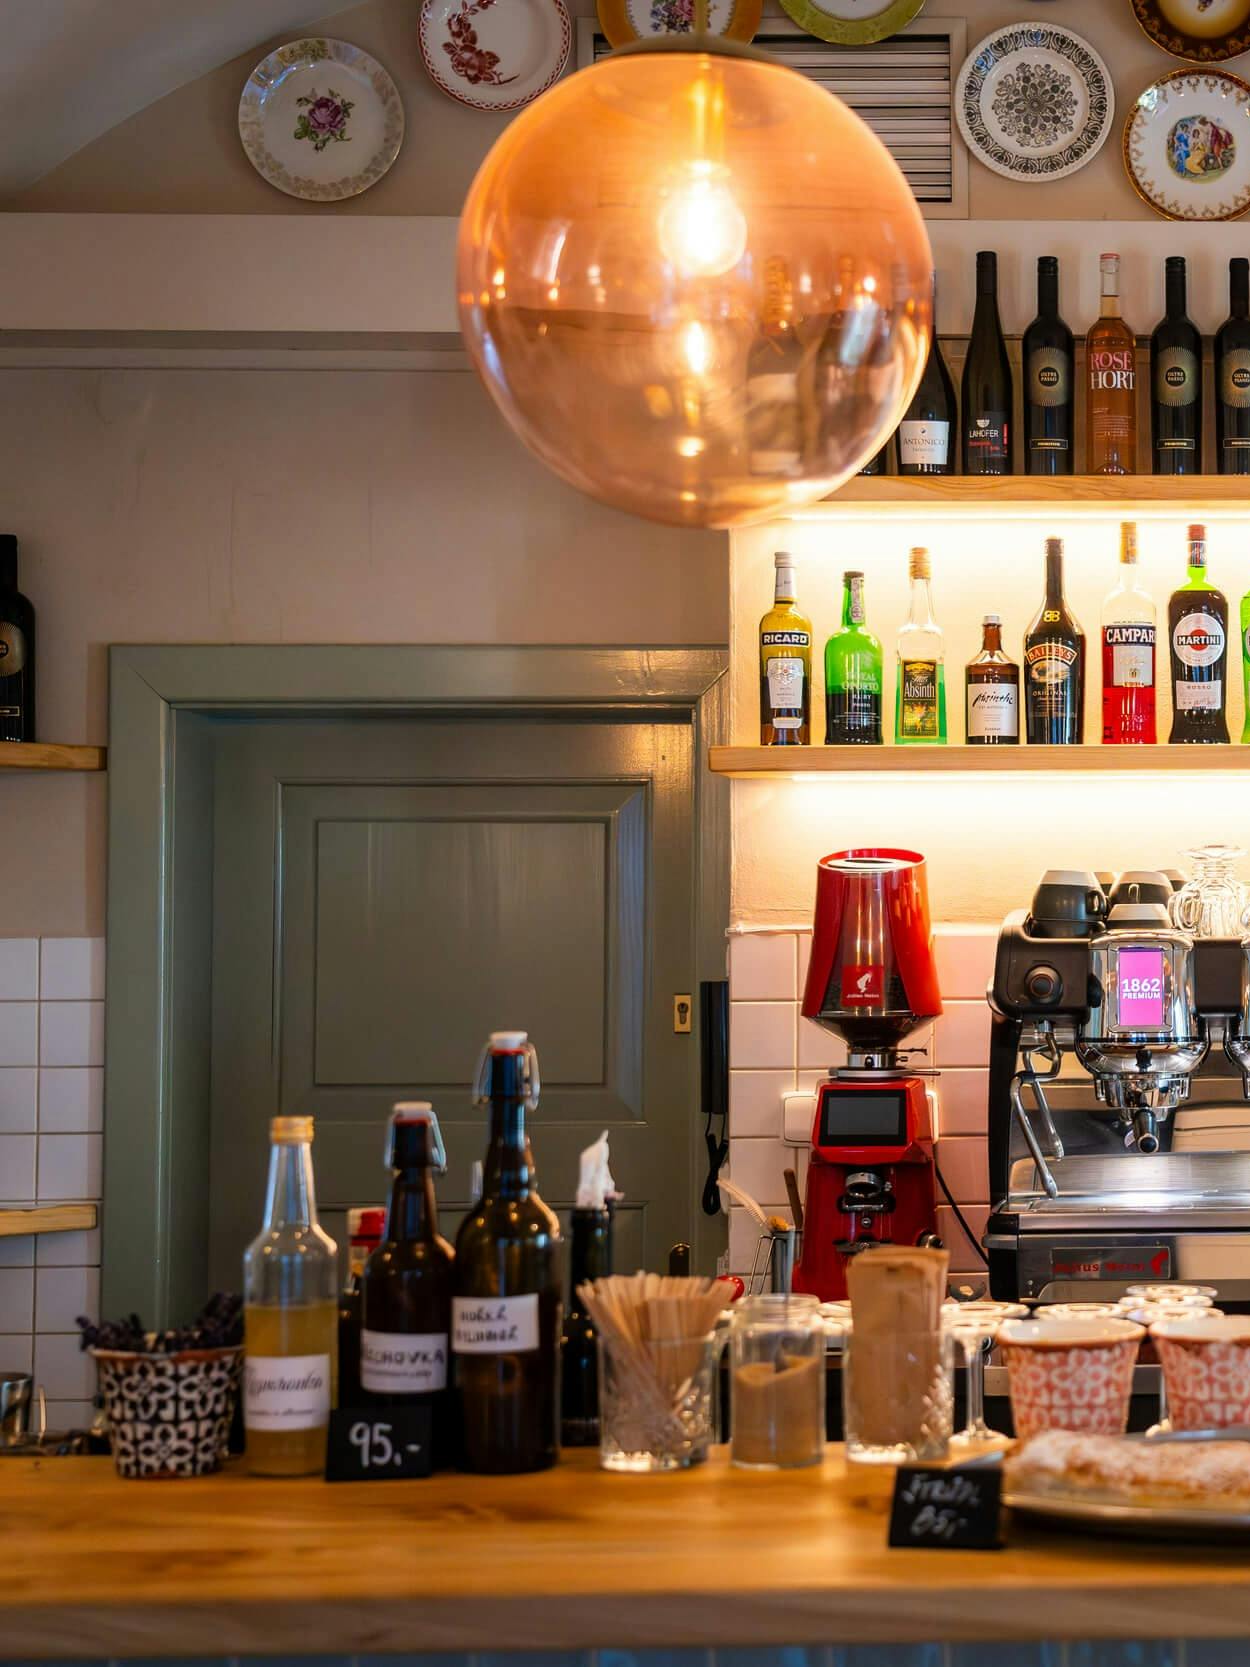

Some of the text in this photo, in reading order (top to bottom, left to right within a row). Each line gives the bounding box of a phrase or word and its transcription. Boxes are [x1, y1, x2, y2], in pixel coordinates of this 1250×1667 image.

[1090, 370, 1136, 390] HORT
[969, 429, 999, 438] LAHOFER
[903, 437, 945, 446] ANTONICO
[763, 634, 808, 644] RICARD
[1178, 636, 1220, 645] MARTINI
[1028, 645, 1075, 662] BAILEYS
[904, 681, 935, 698] Absinth
[1121, 977, 1161, 993] 1862
[1122, 991, 1161, 1000] PREMIUM
